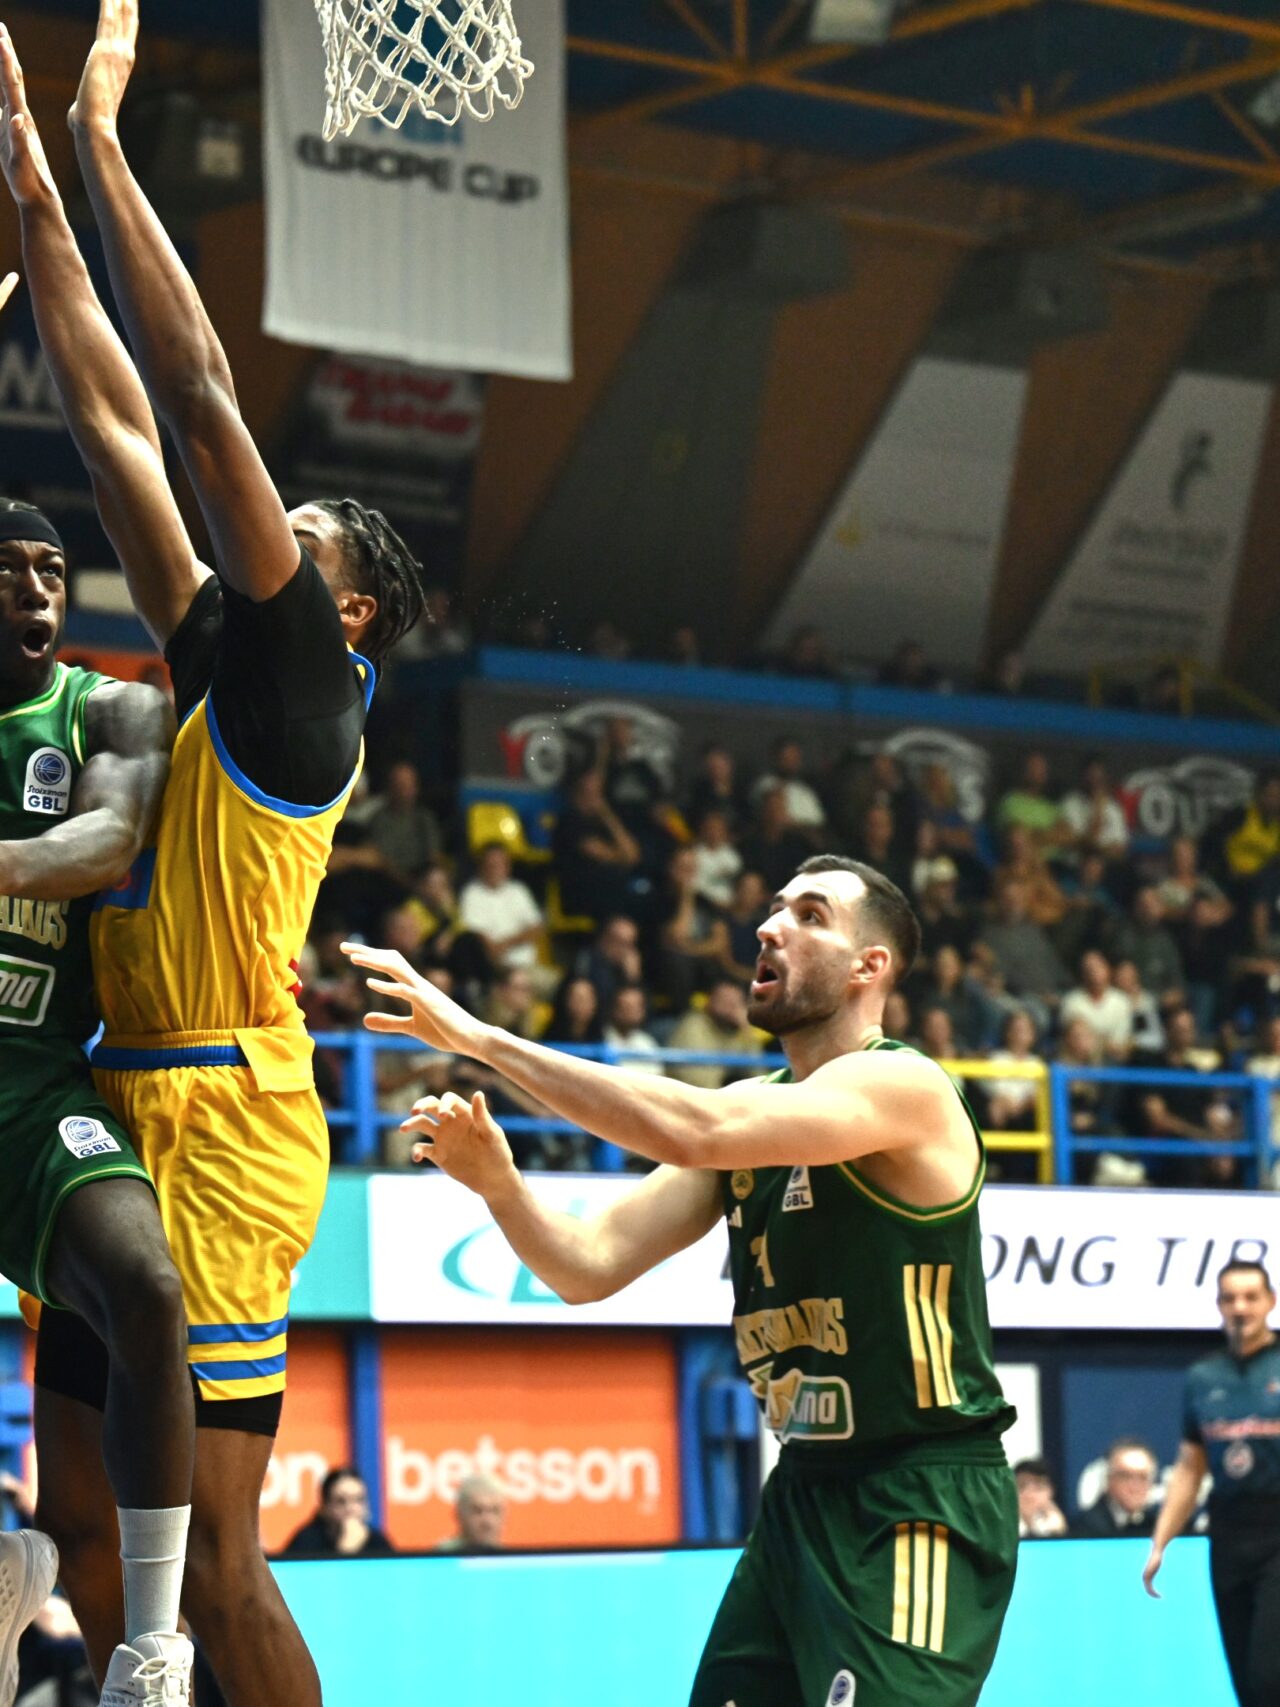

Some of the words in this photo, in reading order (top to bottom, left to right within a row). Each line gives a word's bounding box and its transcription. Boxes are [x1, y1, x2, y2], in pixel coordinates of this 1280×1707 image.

[28, 795, 64, 812] GBL
[80, 1142, 116, 1157] GBL
[386, 1434, 660, 1503] betsson
